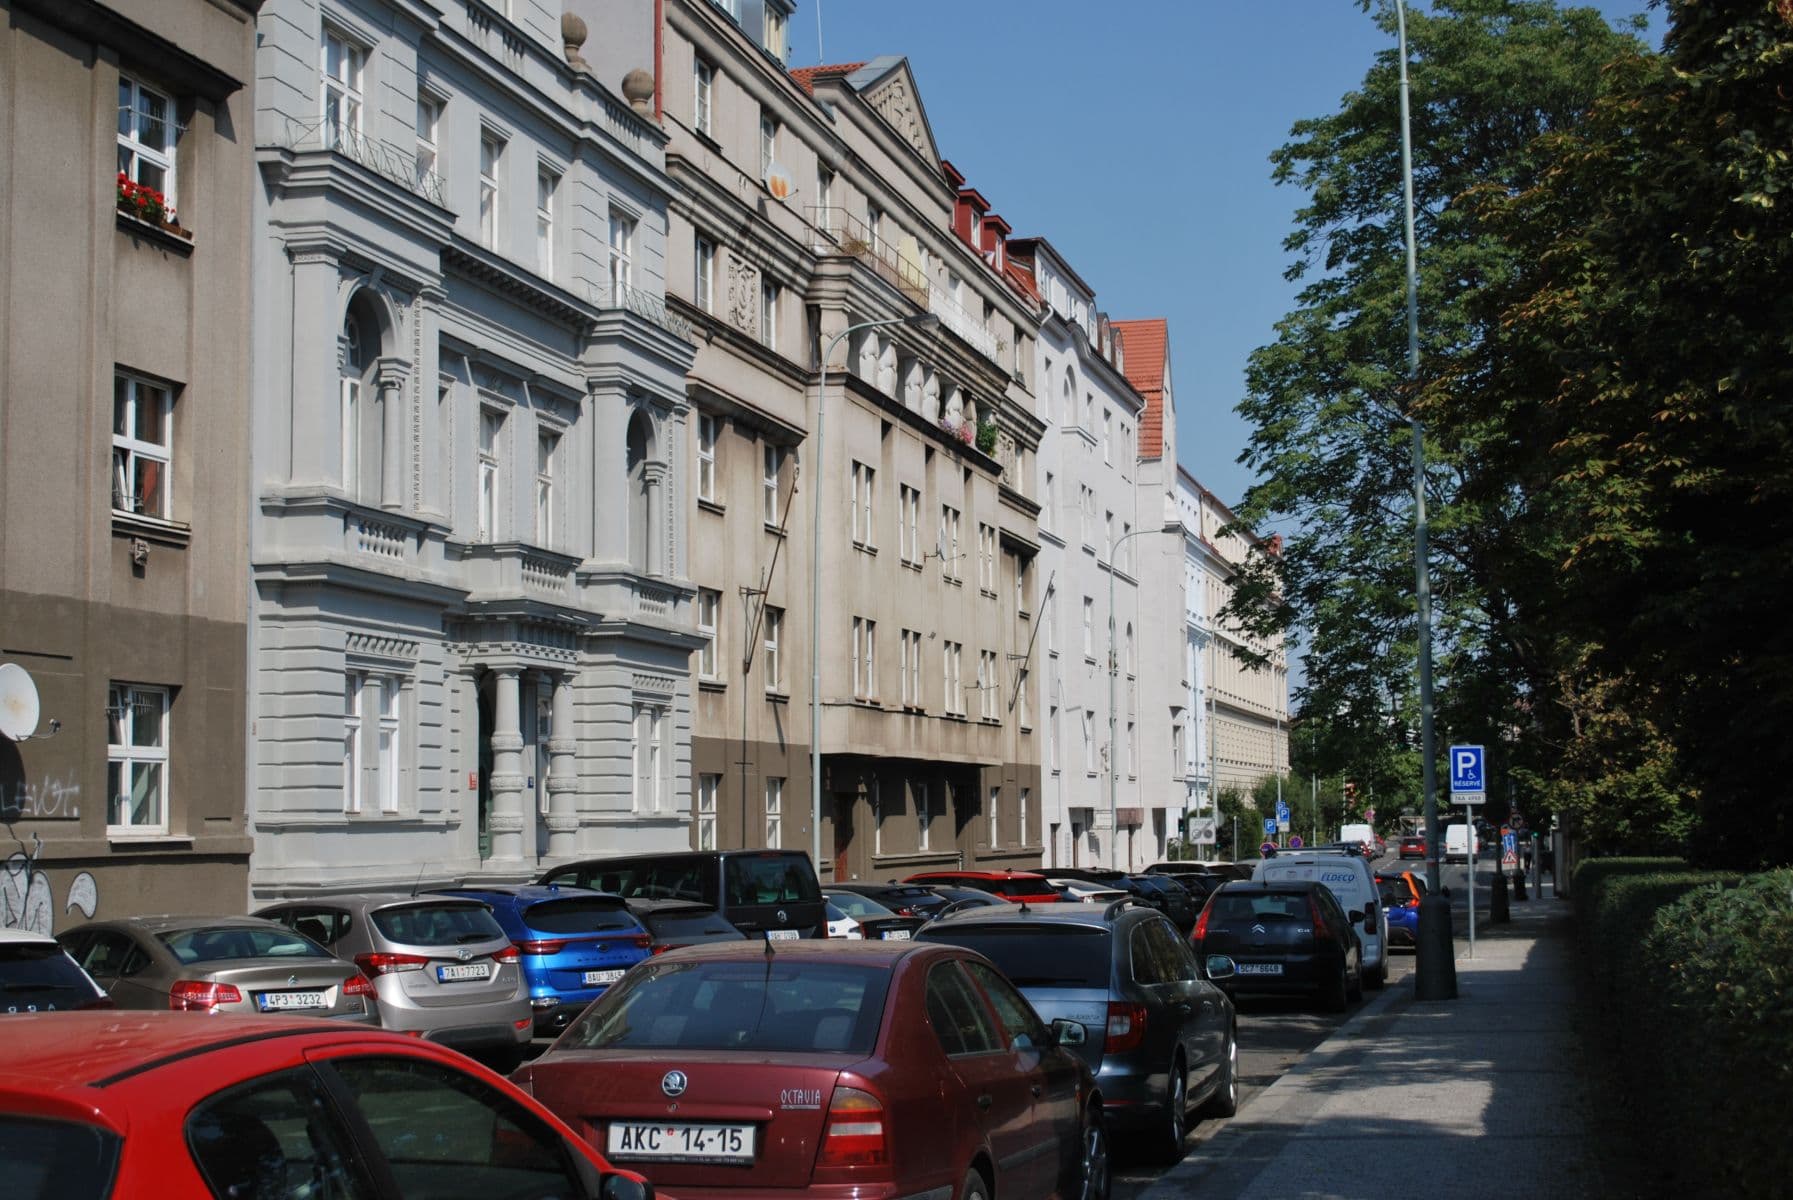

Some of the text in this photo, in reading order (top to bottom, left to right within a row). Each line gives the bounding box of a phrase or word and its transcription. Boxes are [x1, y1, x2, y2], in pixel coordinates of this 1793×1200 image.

[1457, 751, 1476, 778] P
[1267, 821, 1274, 830] P
[465, 966, 485, 977] 7723
[269, 993, 323, 1006] 4P3 3232
[780, 1089, 820, 1104] OCTAVIA
[620, 1126, 743, 1152] AKC 14-15
